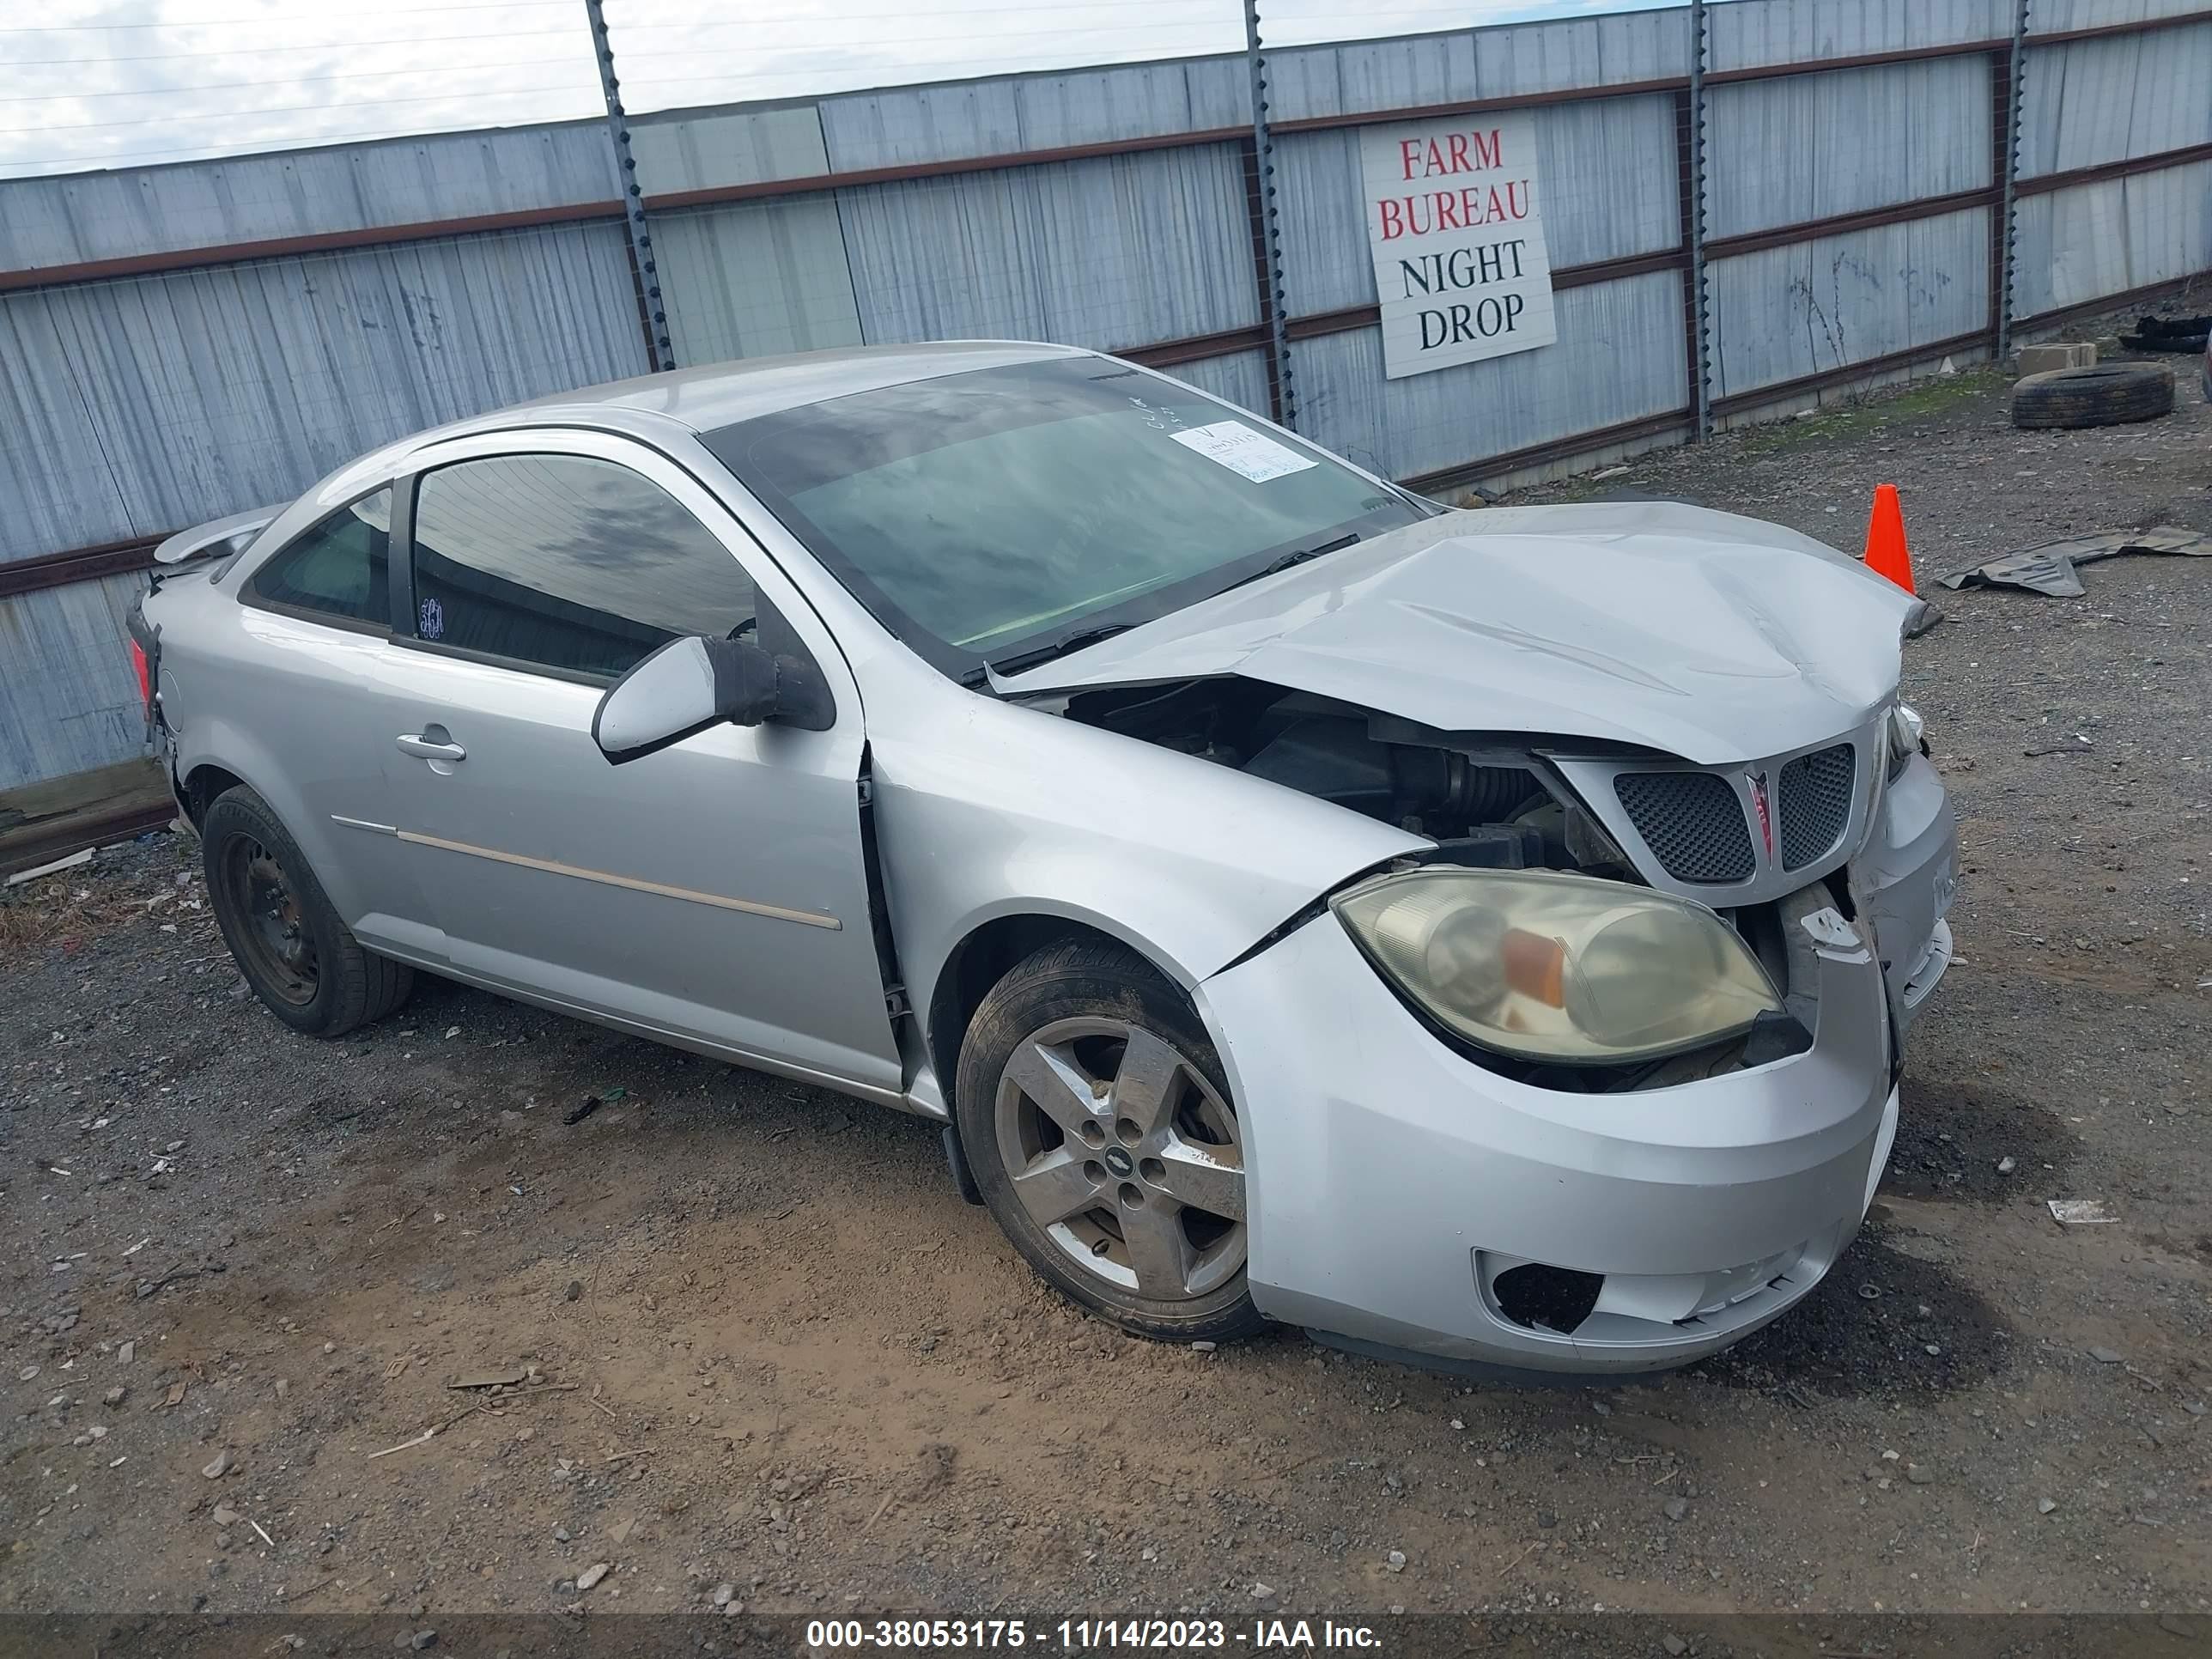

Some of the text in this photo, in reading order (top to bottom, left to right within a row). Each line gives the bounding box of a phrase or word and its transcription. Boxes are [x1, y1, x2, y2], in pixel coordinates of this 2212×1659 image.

[1399, 130, 1503, 180] FARM
[1377, 179, 1529, 241] BUREAU
[1399, 240, 1527, 299] NIGHT
[1417, 294, 1523, 351] DROP
